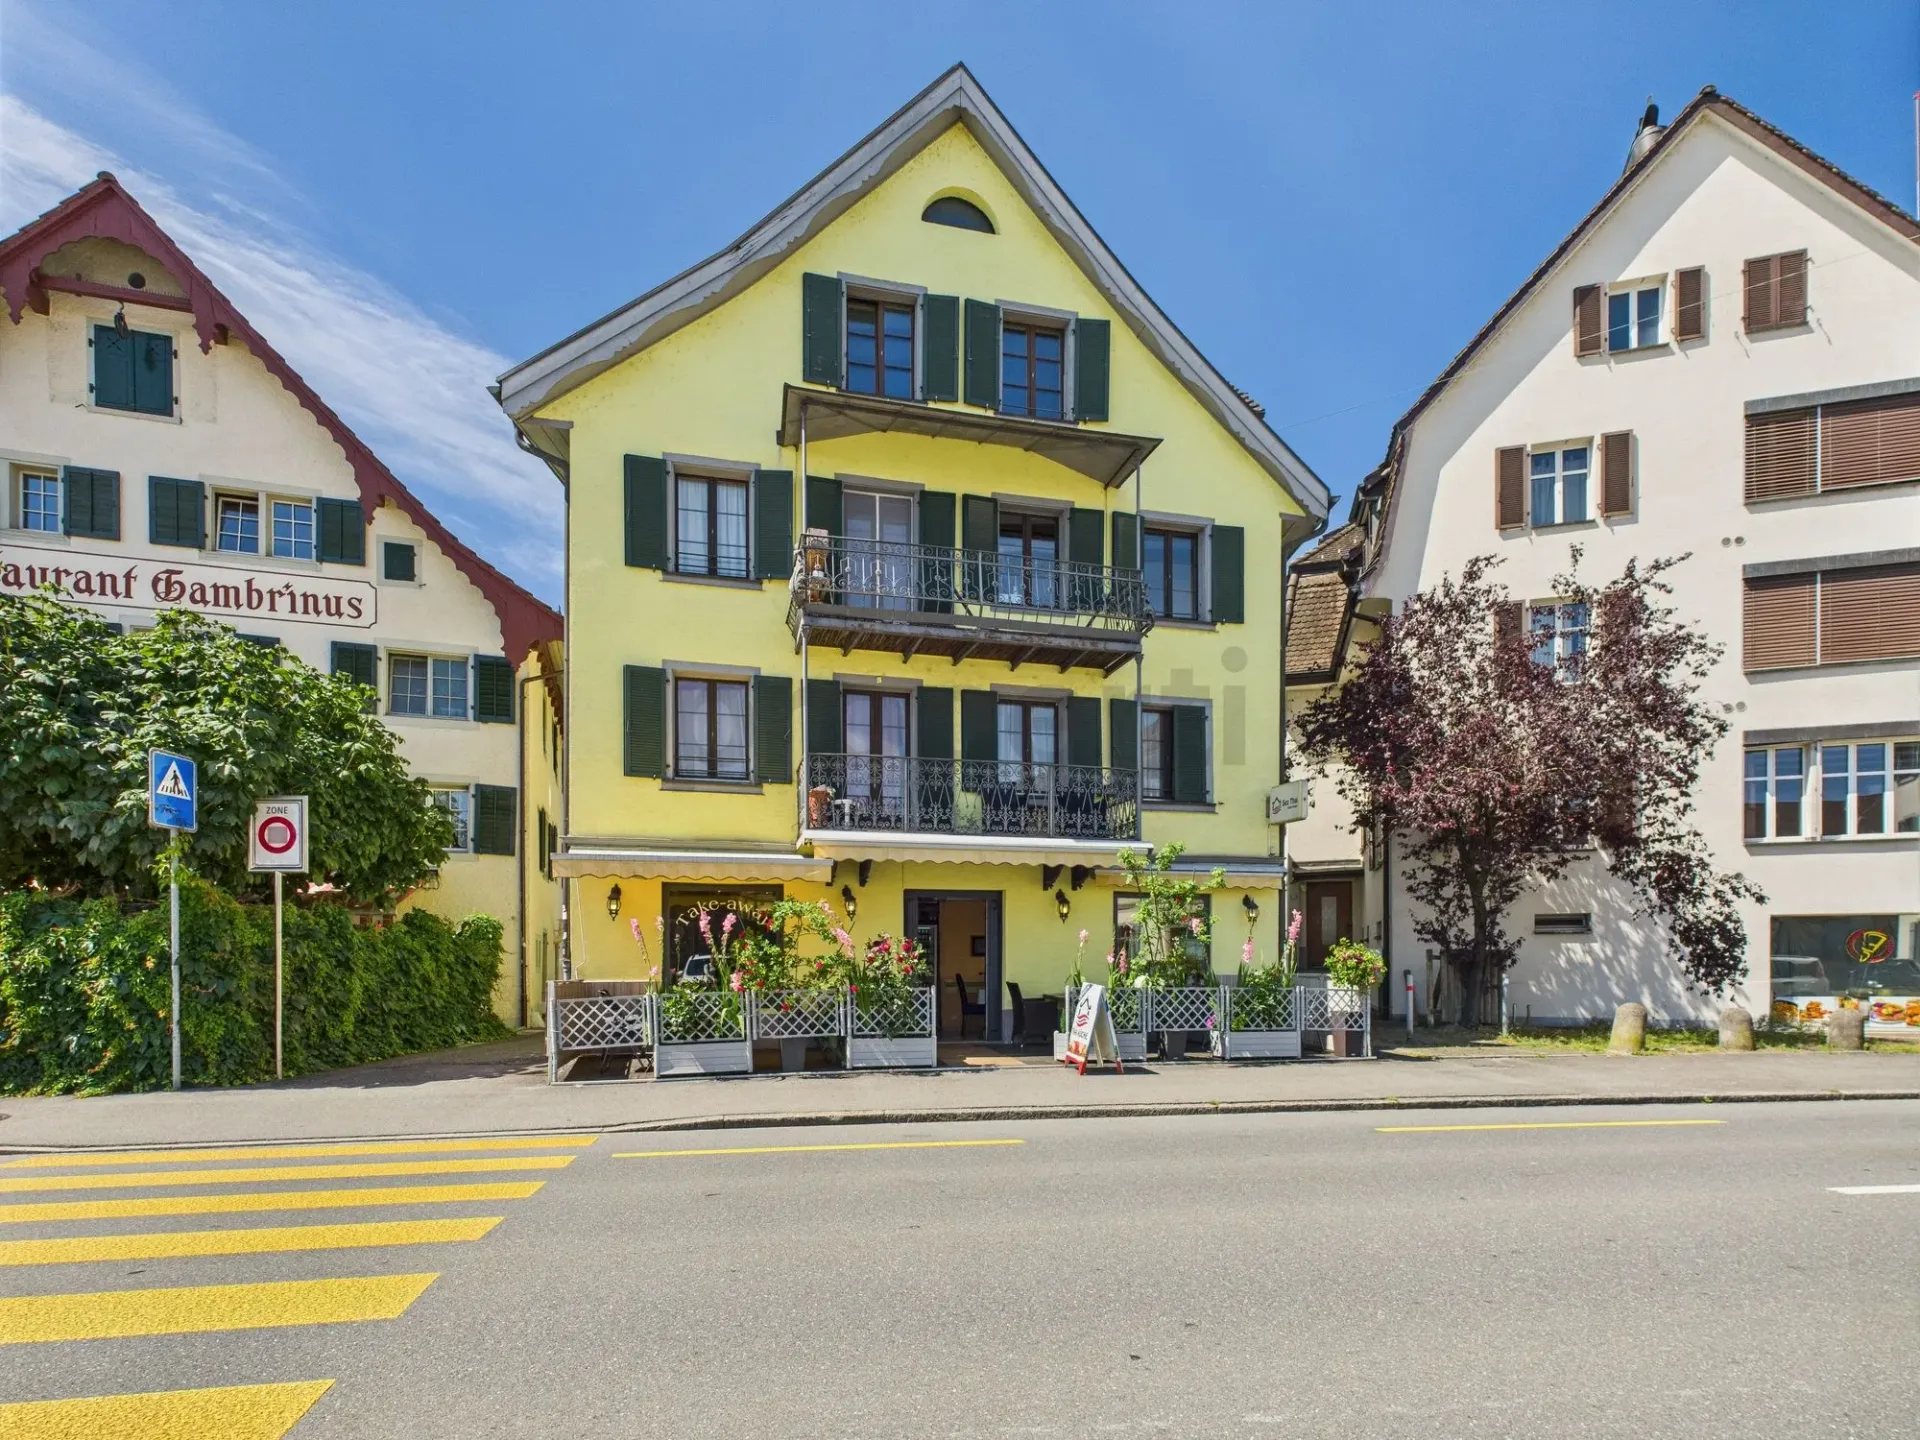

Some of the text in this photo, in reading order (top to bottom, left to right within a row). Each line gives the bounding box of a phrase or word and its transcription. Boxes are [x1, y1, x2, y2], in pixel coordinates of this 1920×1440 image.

[0, 550, 364, 620] aurant Gambrinus
[266, 806, 288, 814] ZONE
